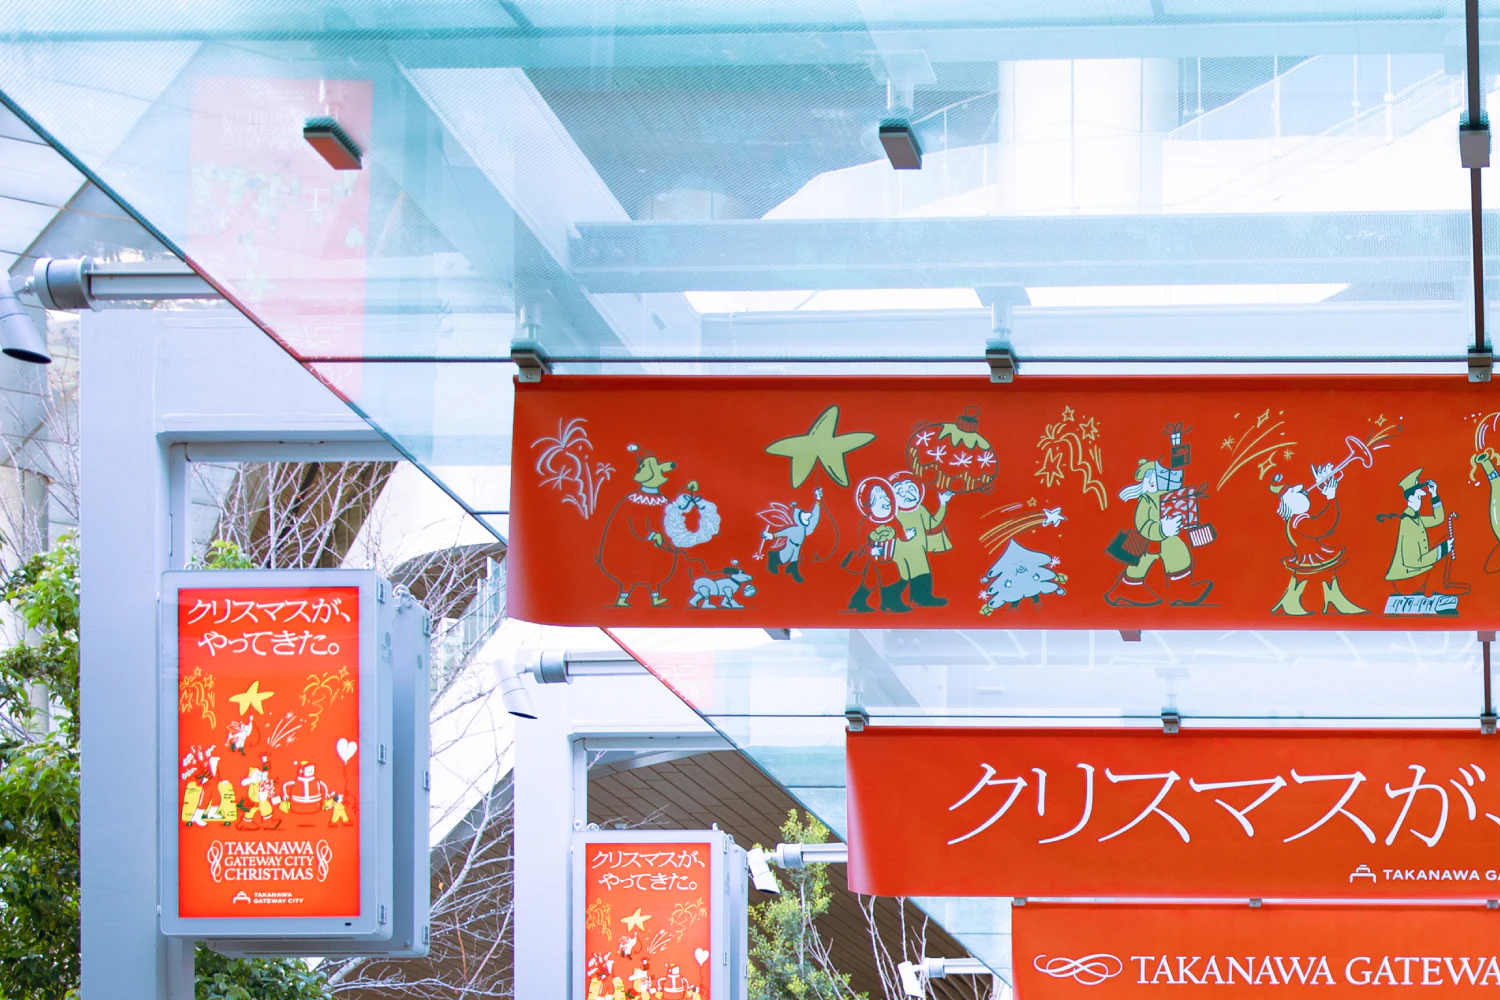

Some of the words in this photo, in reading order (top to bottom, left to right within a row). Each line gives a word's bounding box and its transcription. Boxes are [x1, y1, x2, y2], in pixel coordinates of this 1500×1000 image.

[188, 598, 350, 624] クリスマスが、
[198, 630, 339, 656] やってきた。
[225, 841, 313, 855] TAKANAWA
[225, 856, 281, 866] GATEWAY
[285, 856, 314, 866] CITY
[592, 850, 705, 868] クリスマスが、
[225, 868, 313, 880] CHRISTMAS
[599, 873, 697, 890] やってきた。
[1383, 870, 1480, 880] TAKANAWA
[1131, 955, 1336, 984] TAKANAWA
